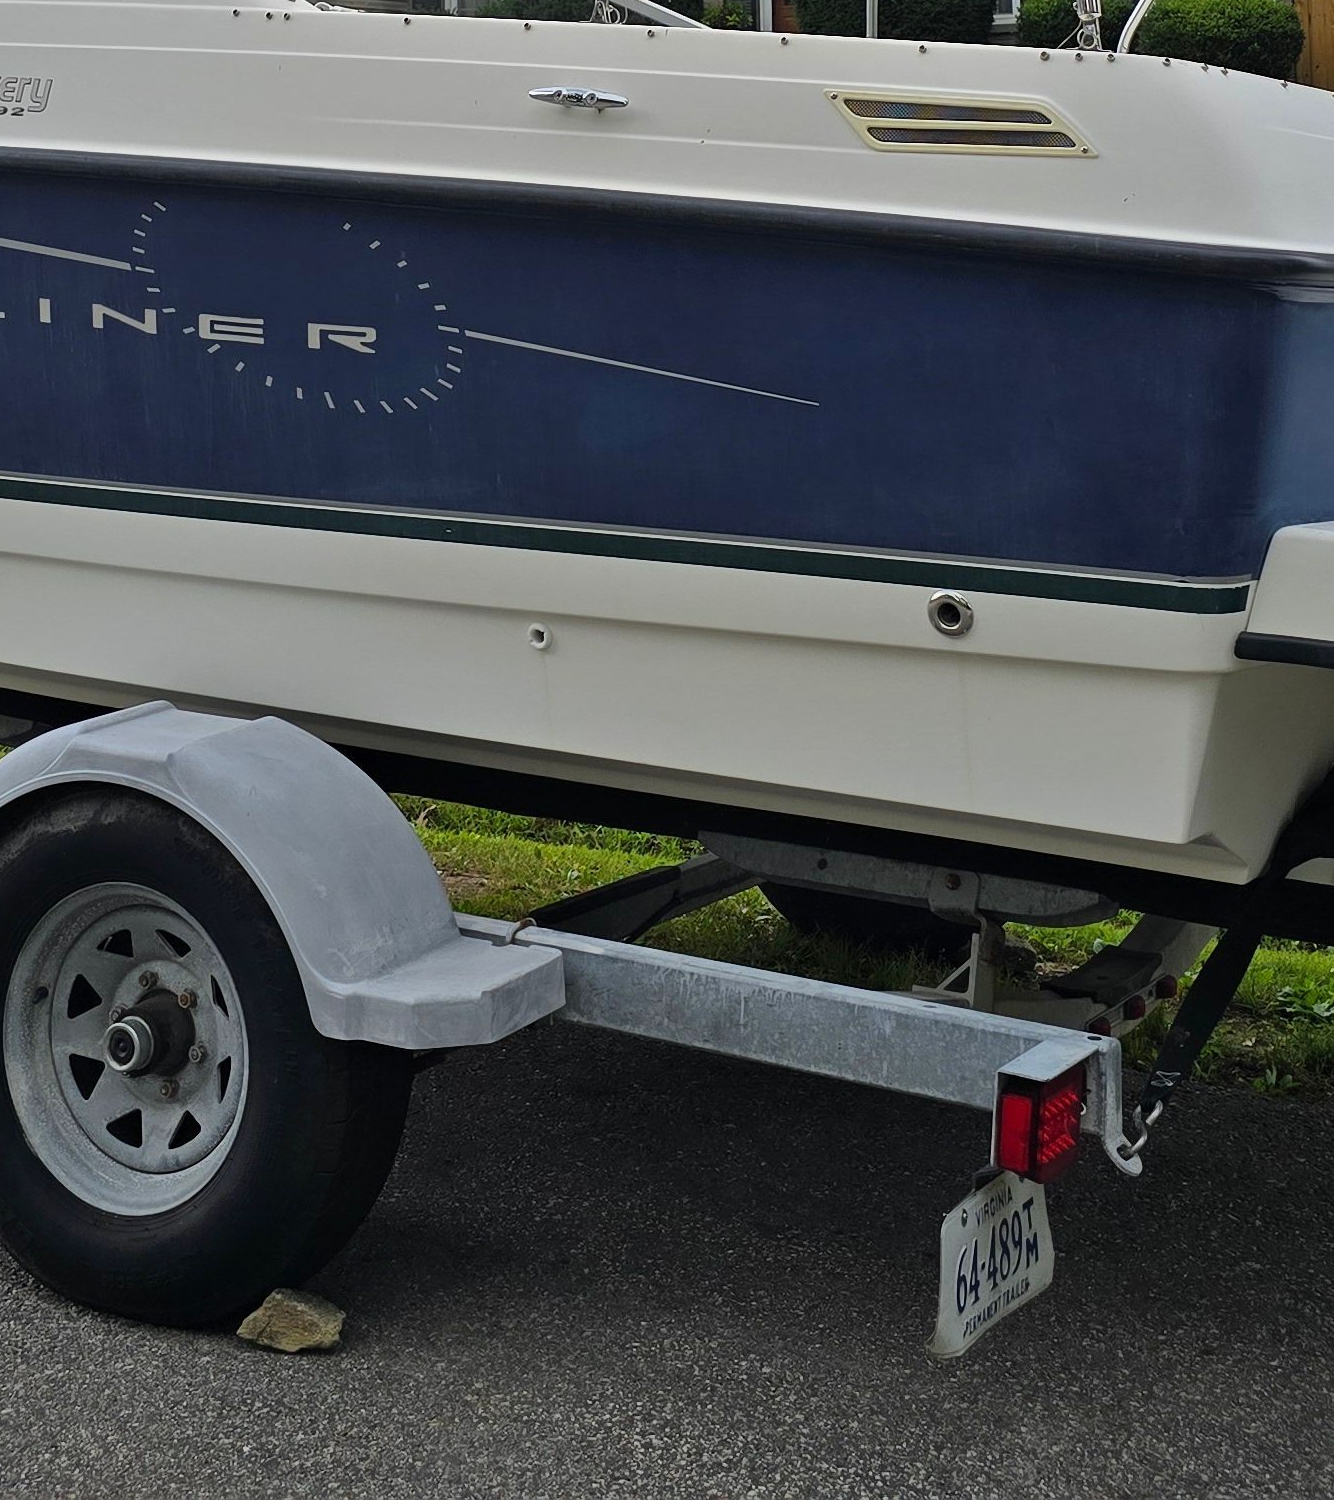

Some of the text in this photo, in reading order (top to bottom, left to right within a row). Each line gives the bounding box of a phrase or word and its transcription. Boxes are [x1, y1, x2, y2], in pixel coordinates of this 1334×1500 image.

[974, 1185, 1014, 1229] VIRGINIA
[962, 1275, 1031, 1340] PERMANENT TRAILER
